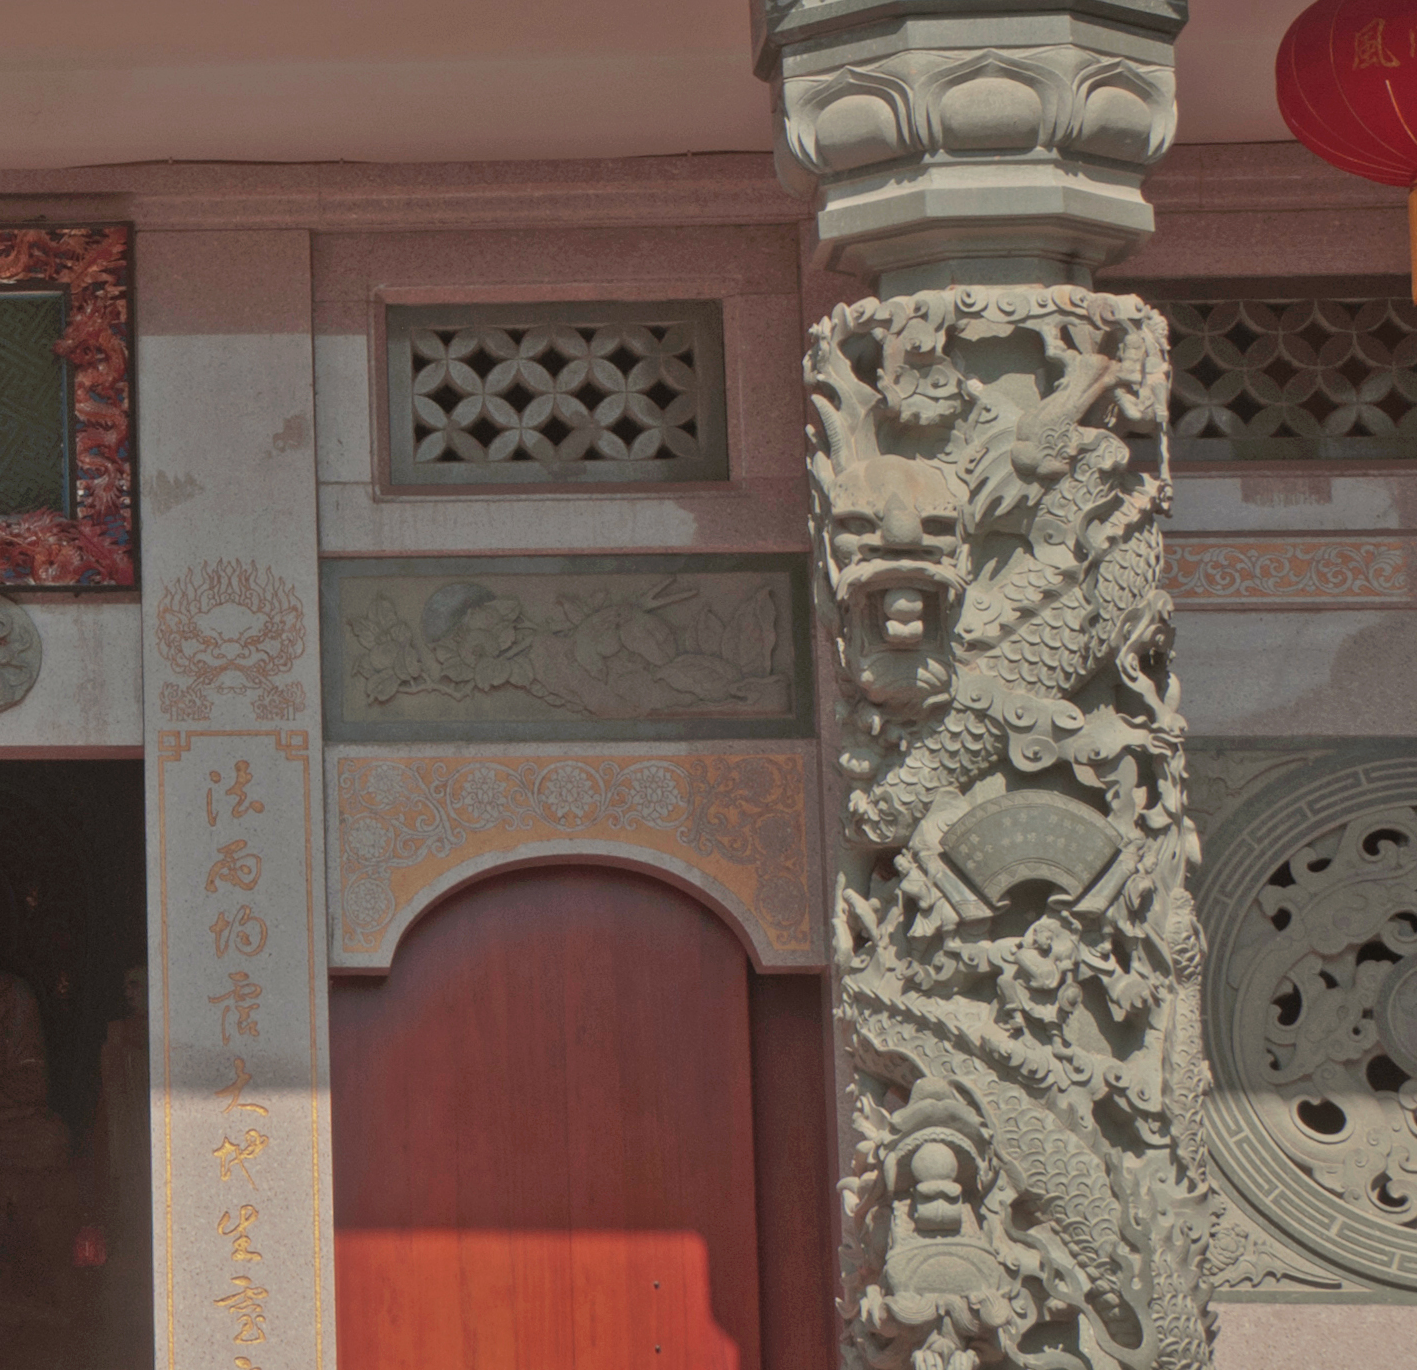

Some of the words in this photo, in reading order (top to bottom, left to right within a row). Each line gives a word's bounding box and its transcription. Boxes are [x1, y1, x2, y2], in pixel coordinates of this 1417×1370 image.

[1352, 18, 1417, 71] 風
[205, 759, 270, 1370] 法雨均霑大地生靈
